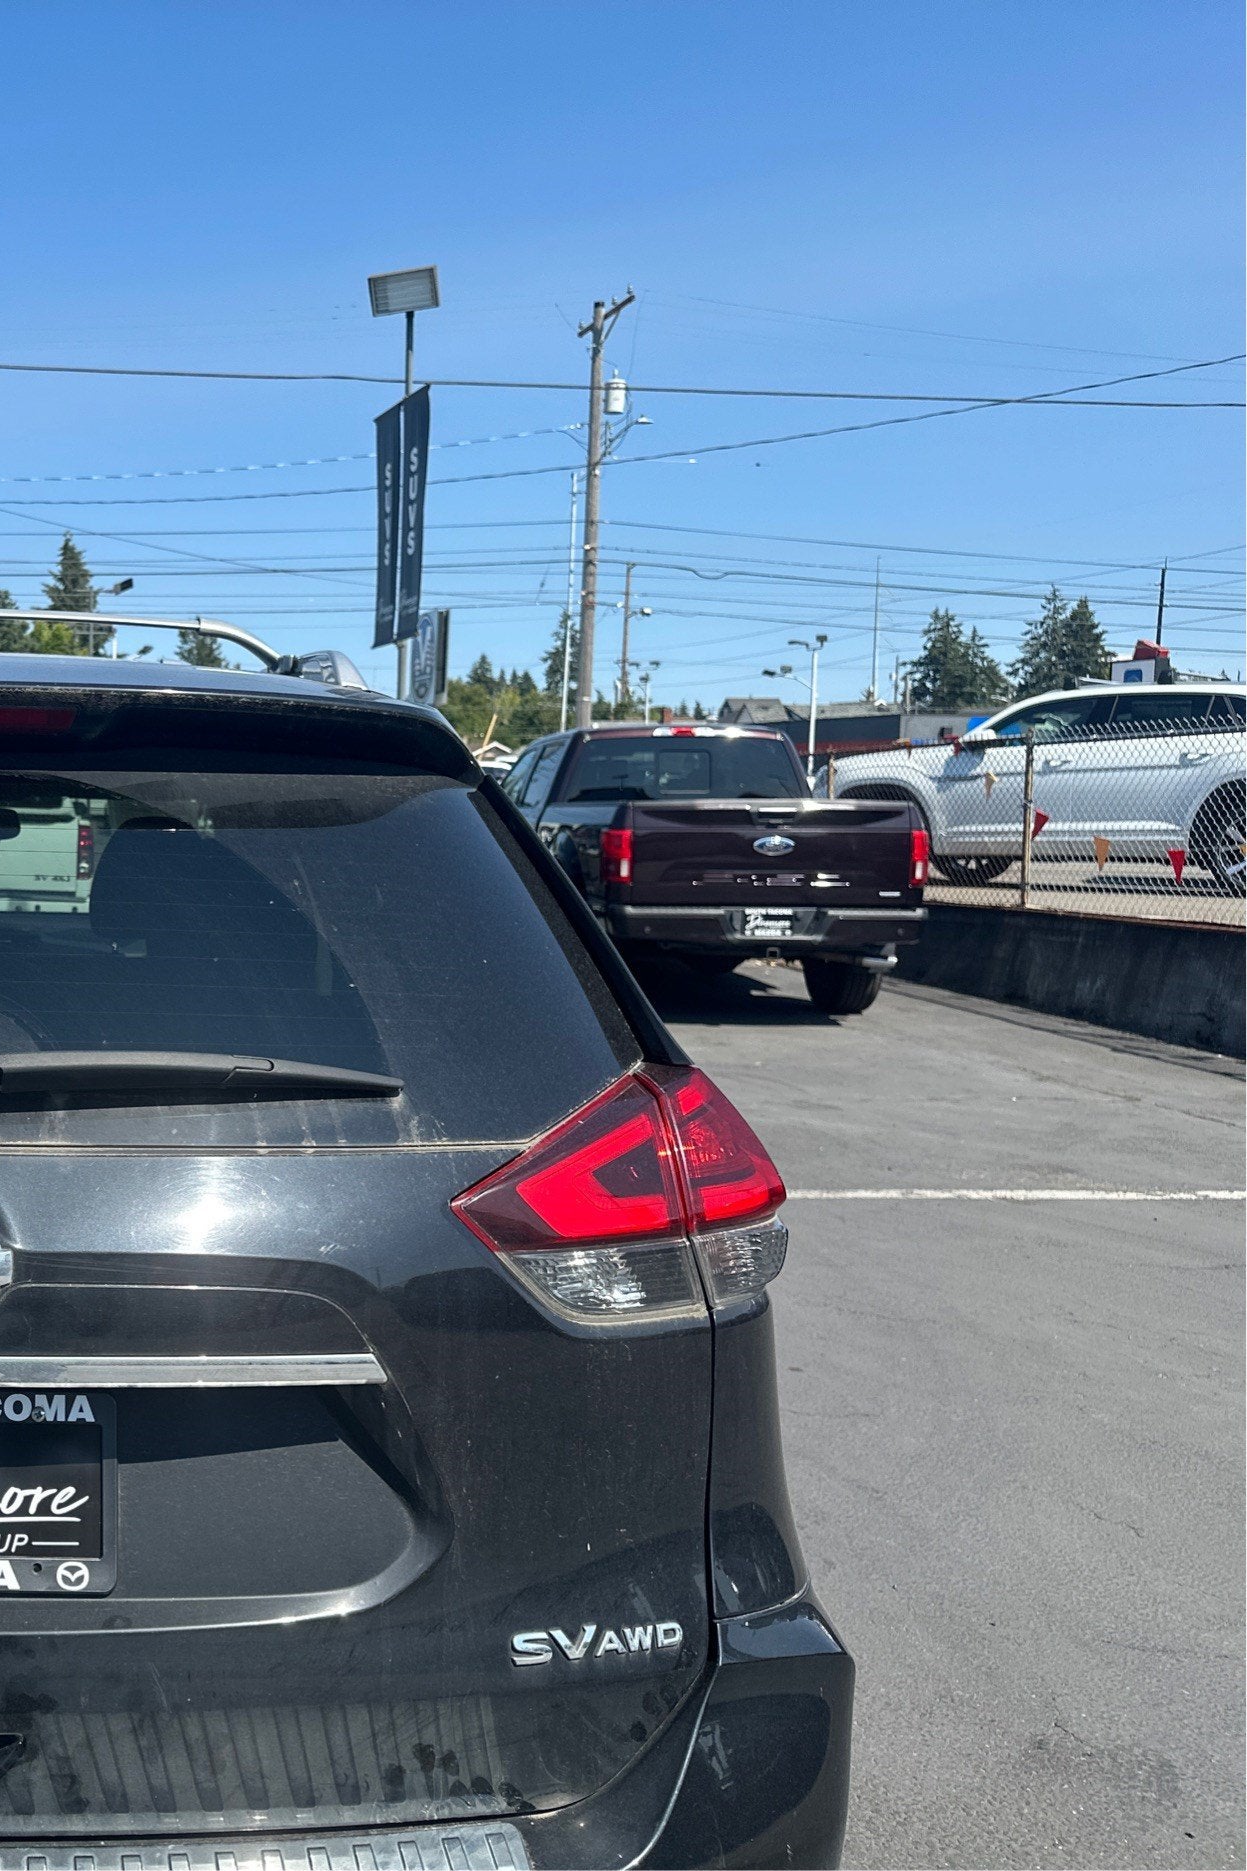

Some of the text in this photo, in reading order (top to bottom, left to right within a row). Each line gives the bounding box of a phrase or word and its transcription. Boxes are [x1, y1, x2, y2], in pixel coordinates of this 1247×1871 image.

[407, 447, 419, 556] SUVS
[511, 1622, 683, 1666] SV AWD
